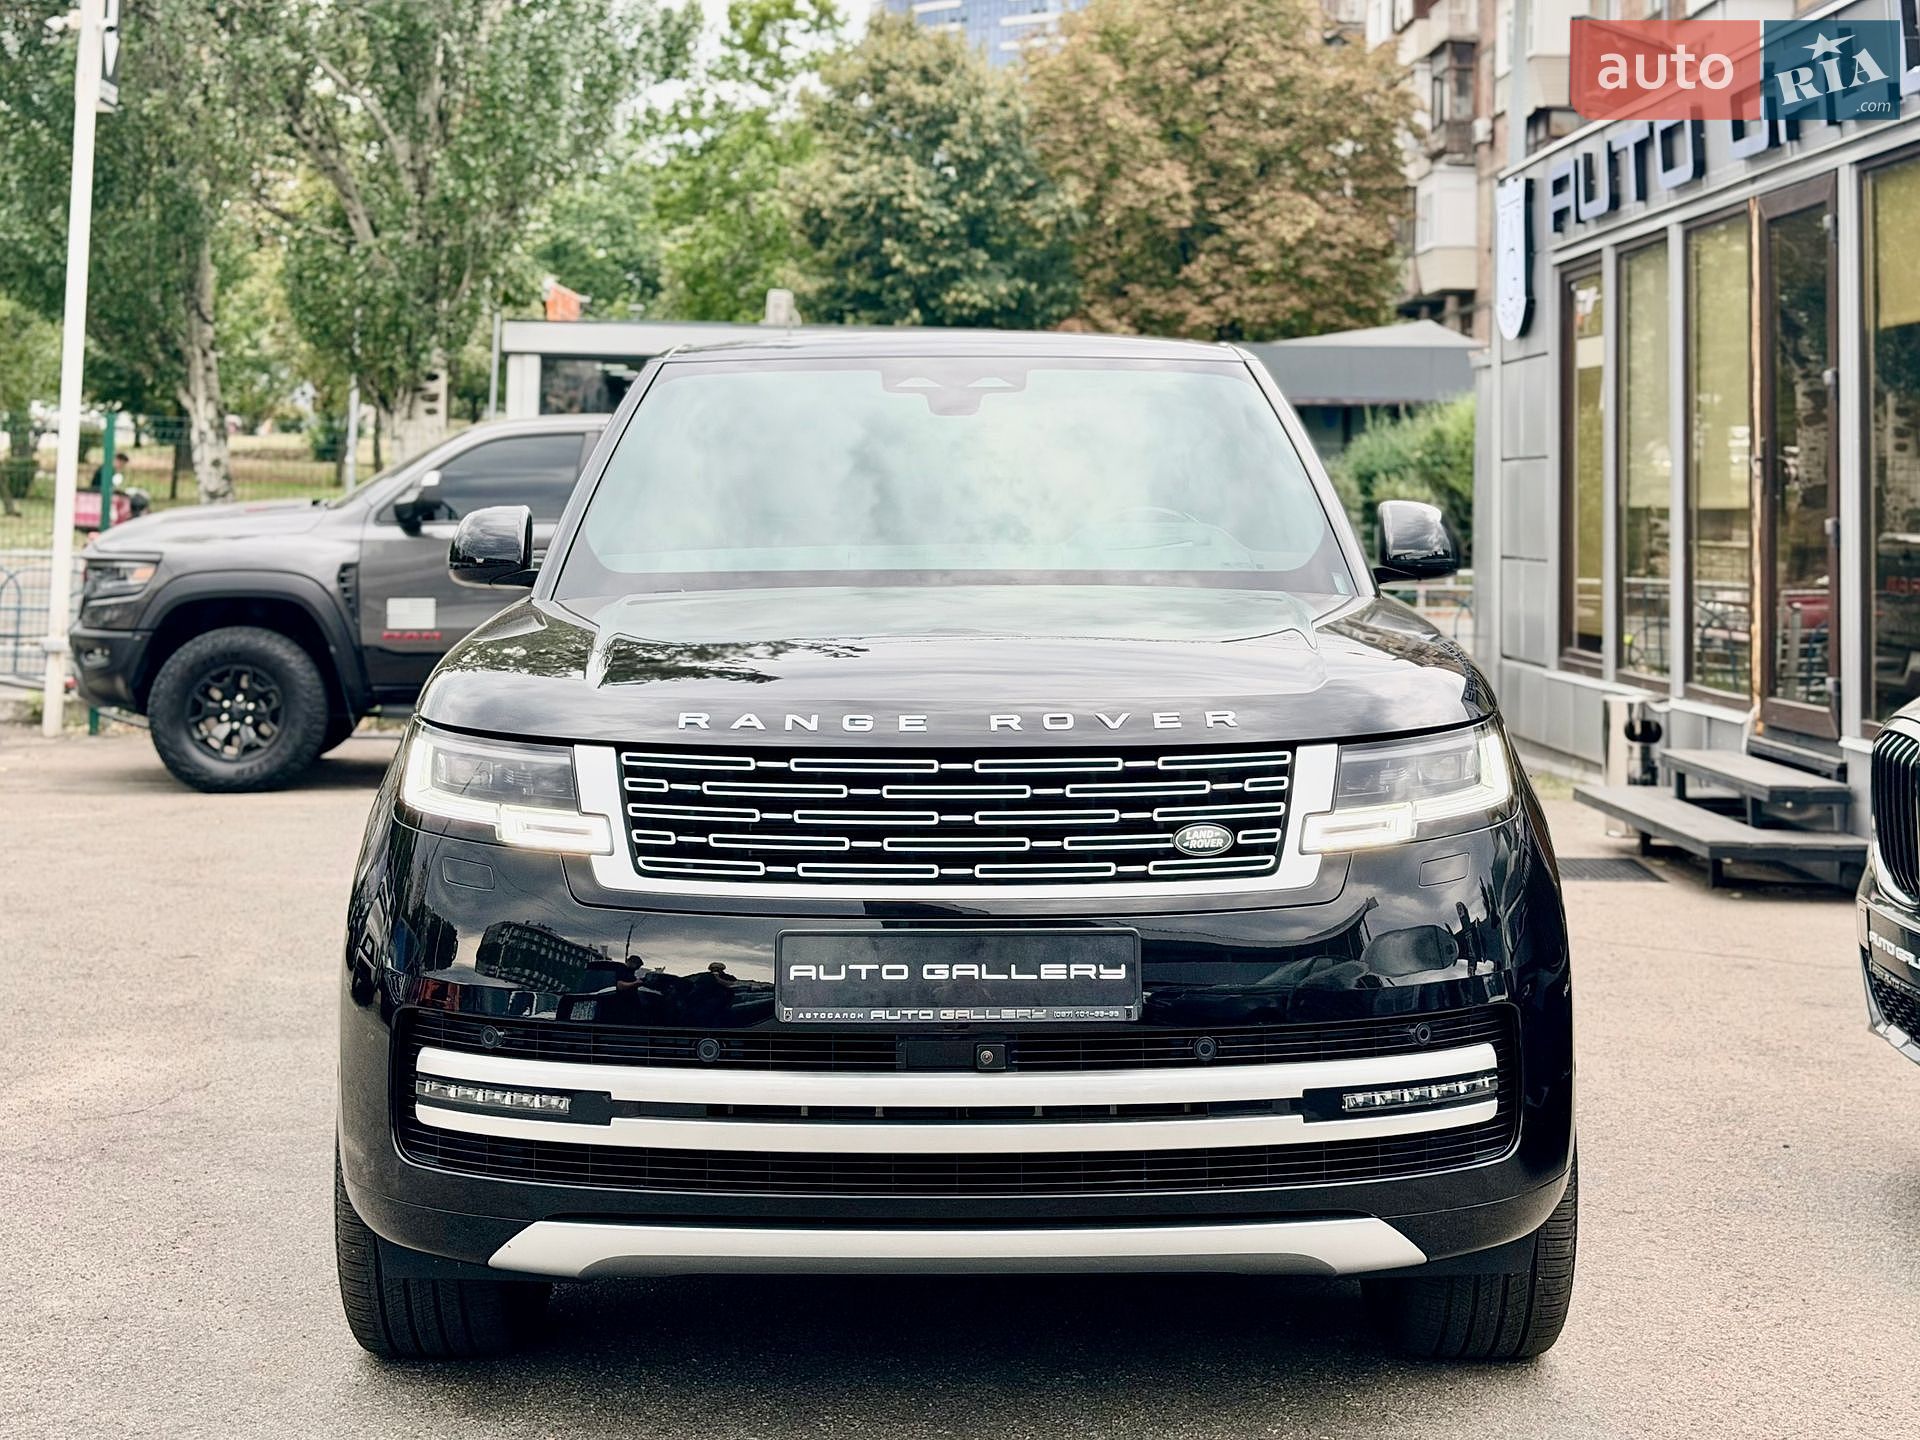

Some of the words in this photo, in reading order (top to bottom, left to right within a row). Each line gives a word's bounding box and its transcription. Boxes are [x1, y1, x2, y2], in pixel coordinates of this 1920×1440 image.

[677, 711, 928, 732] RANGE
[989, 709, 1239, 732] ROVER
[1185, 828, 1214, 841] LAND
[1189, 838, 1224, 849] ROVER
[789, 964, 909, 981] AUTO
[922, 963, 1127, 981] GALLERY
[870, 1009, 934, 1021] AUTO
[939, 1009, 1047, 1020] GALLERY
